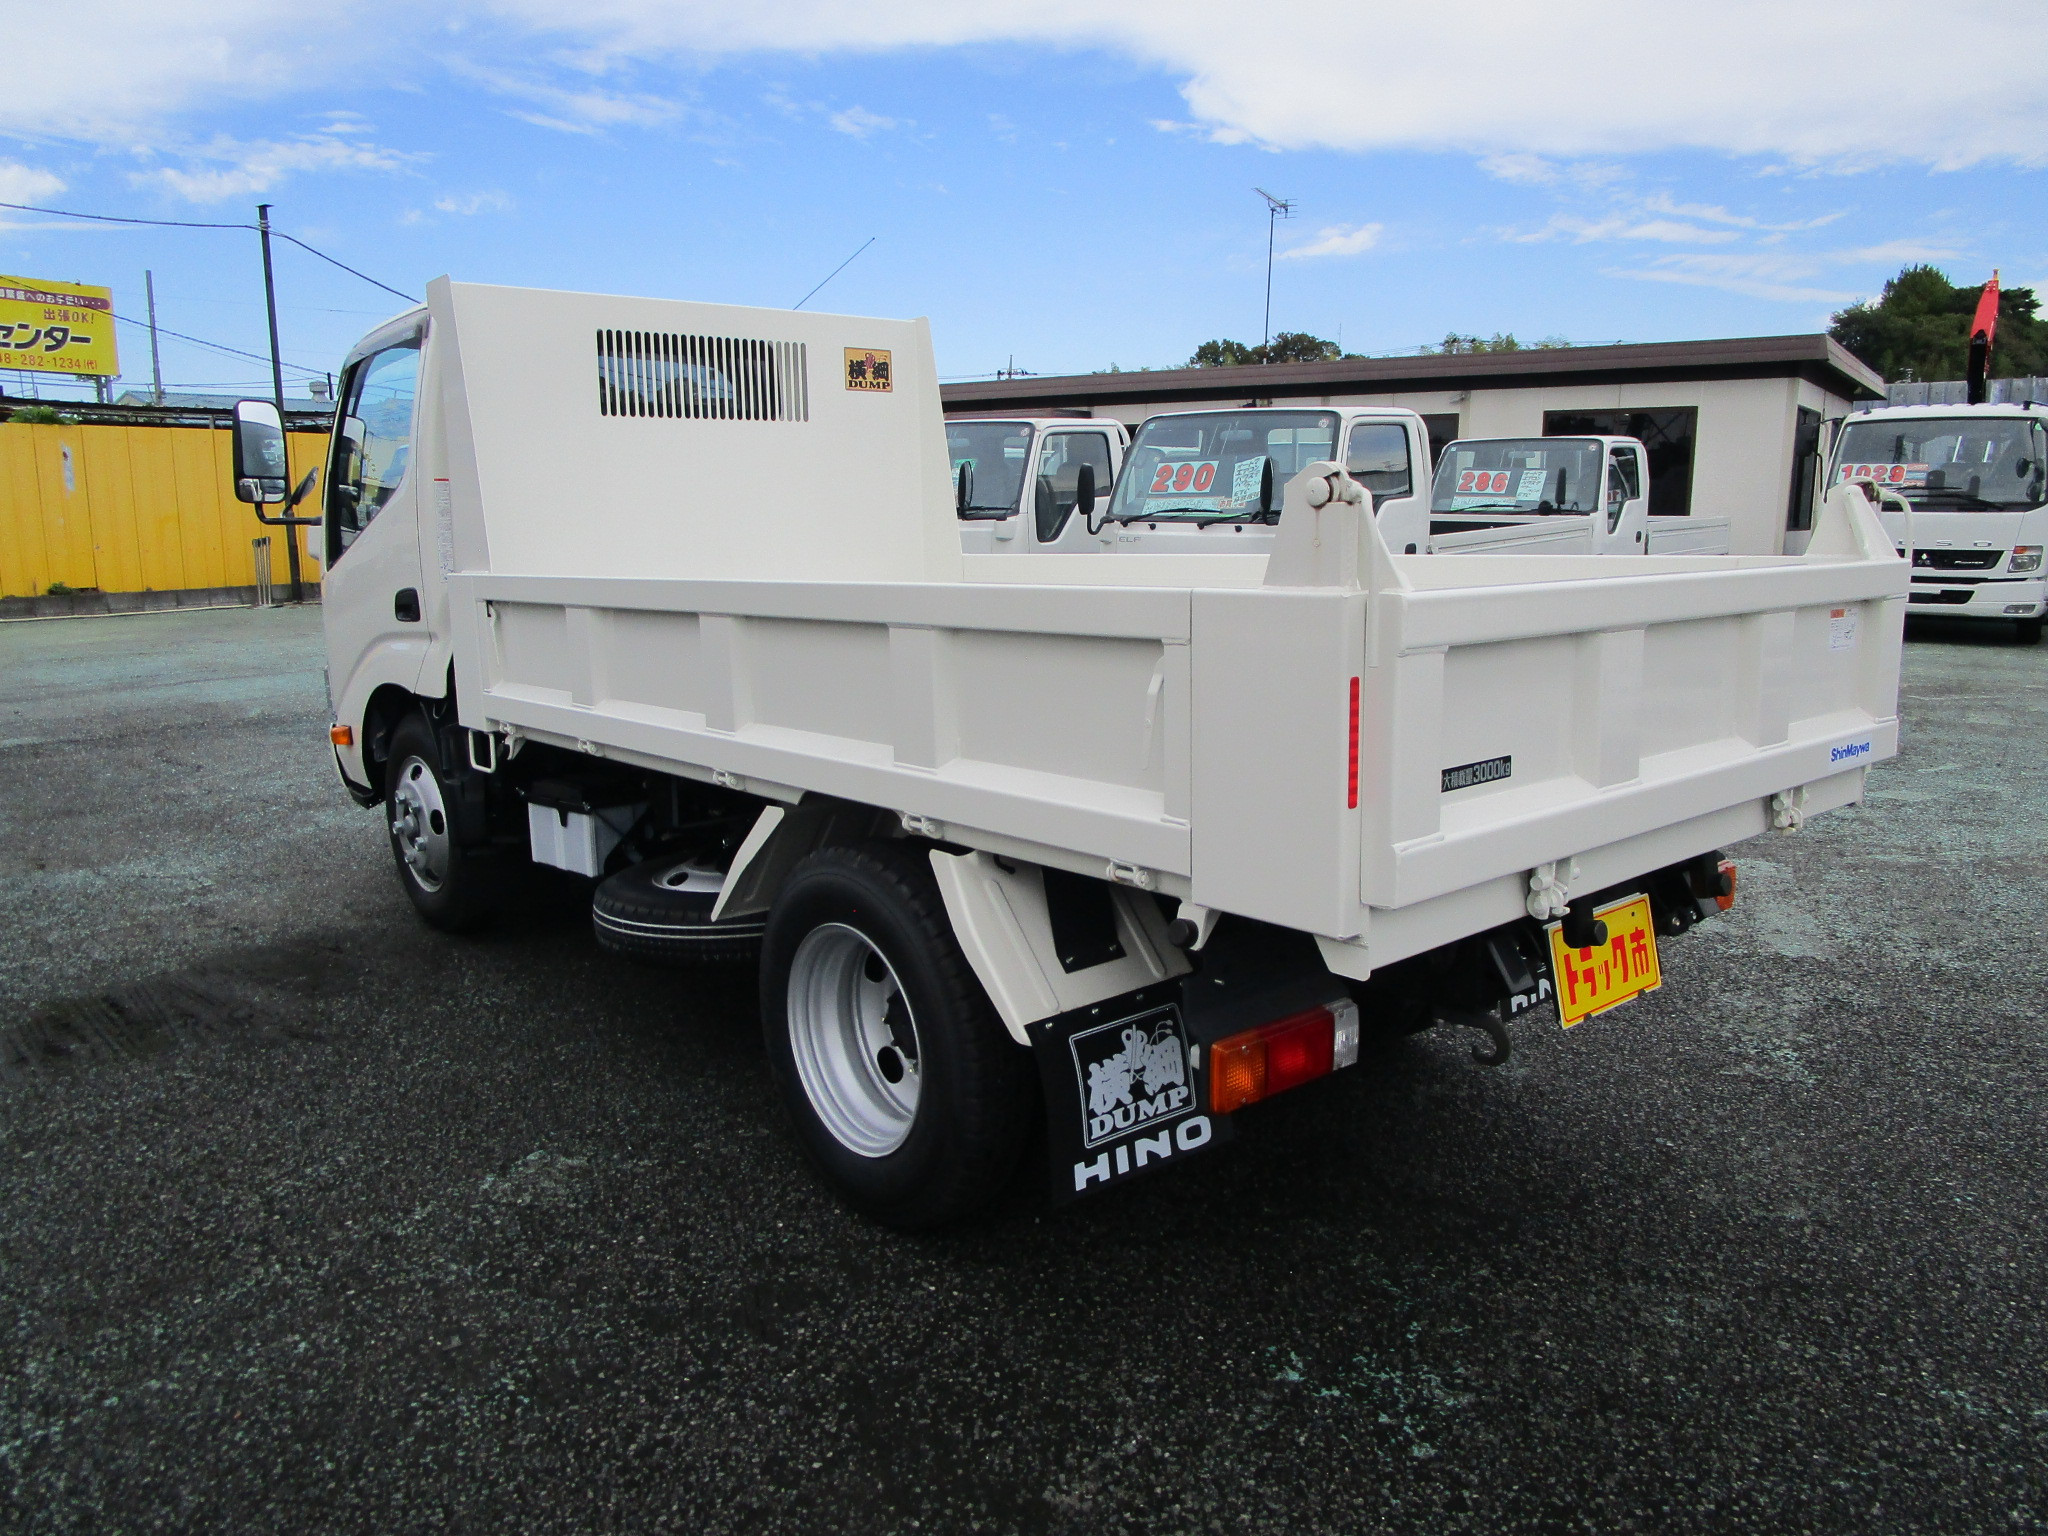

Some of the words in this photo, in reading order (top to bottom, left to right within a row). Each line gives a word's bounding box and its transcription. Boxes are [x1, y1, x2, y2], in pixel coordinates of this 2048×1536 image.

[848, 380, 890, 389] DUMP
[1151, 463, 1216, 492] 290
[1458, 472, 1508, 492] 286
[1831, 742, 1870, 762] ShinMaywa
[1563, 926, 1650, 1006] トラック市
[1090, 1086, 1189, 1140] DUMP
[1074, 1115, 1212, 1192] HINO
